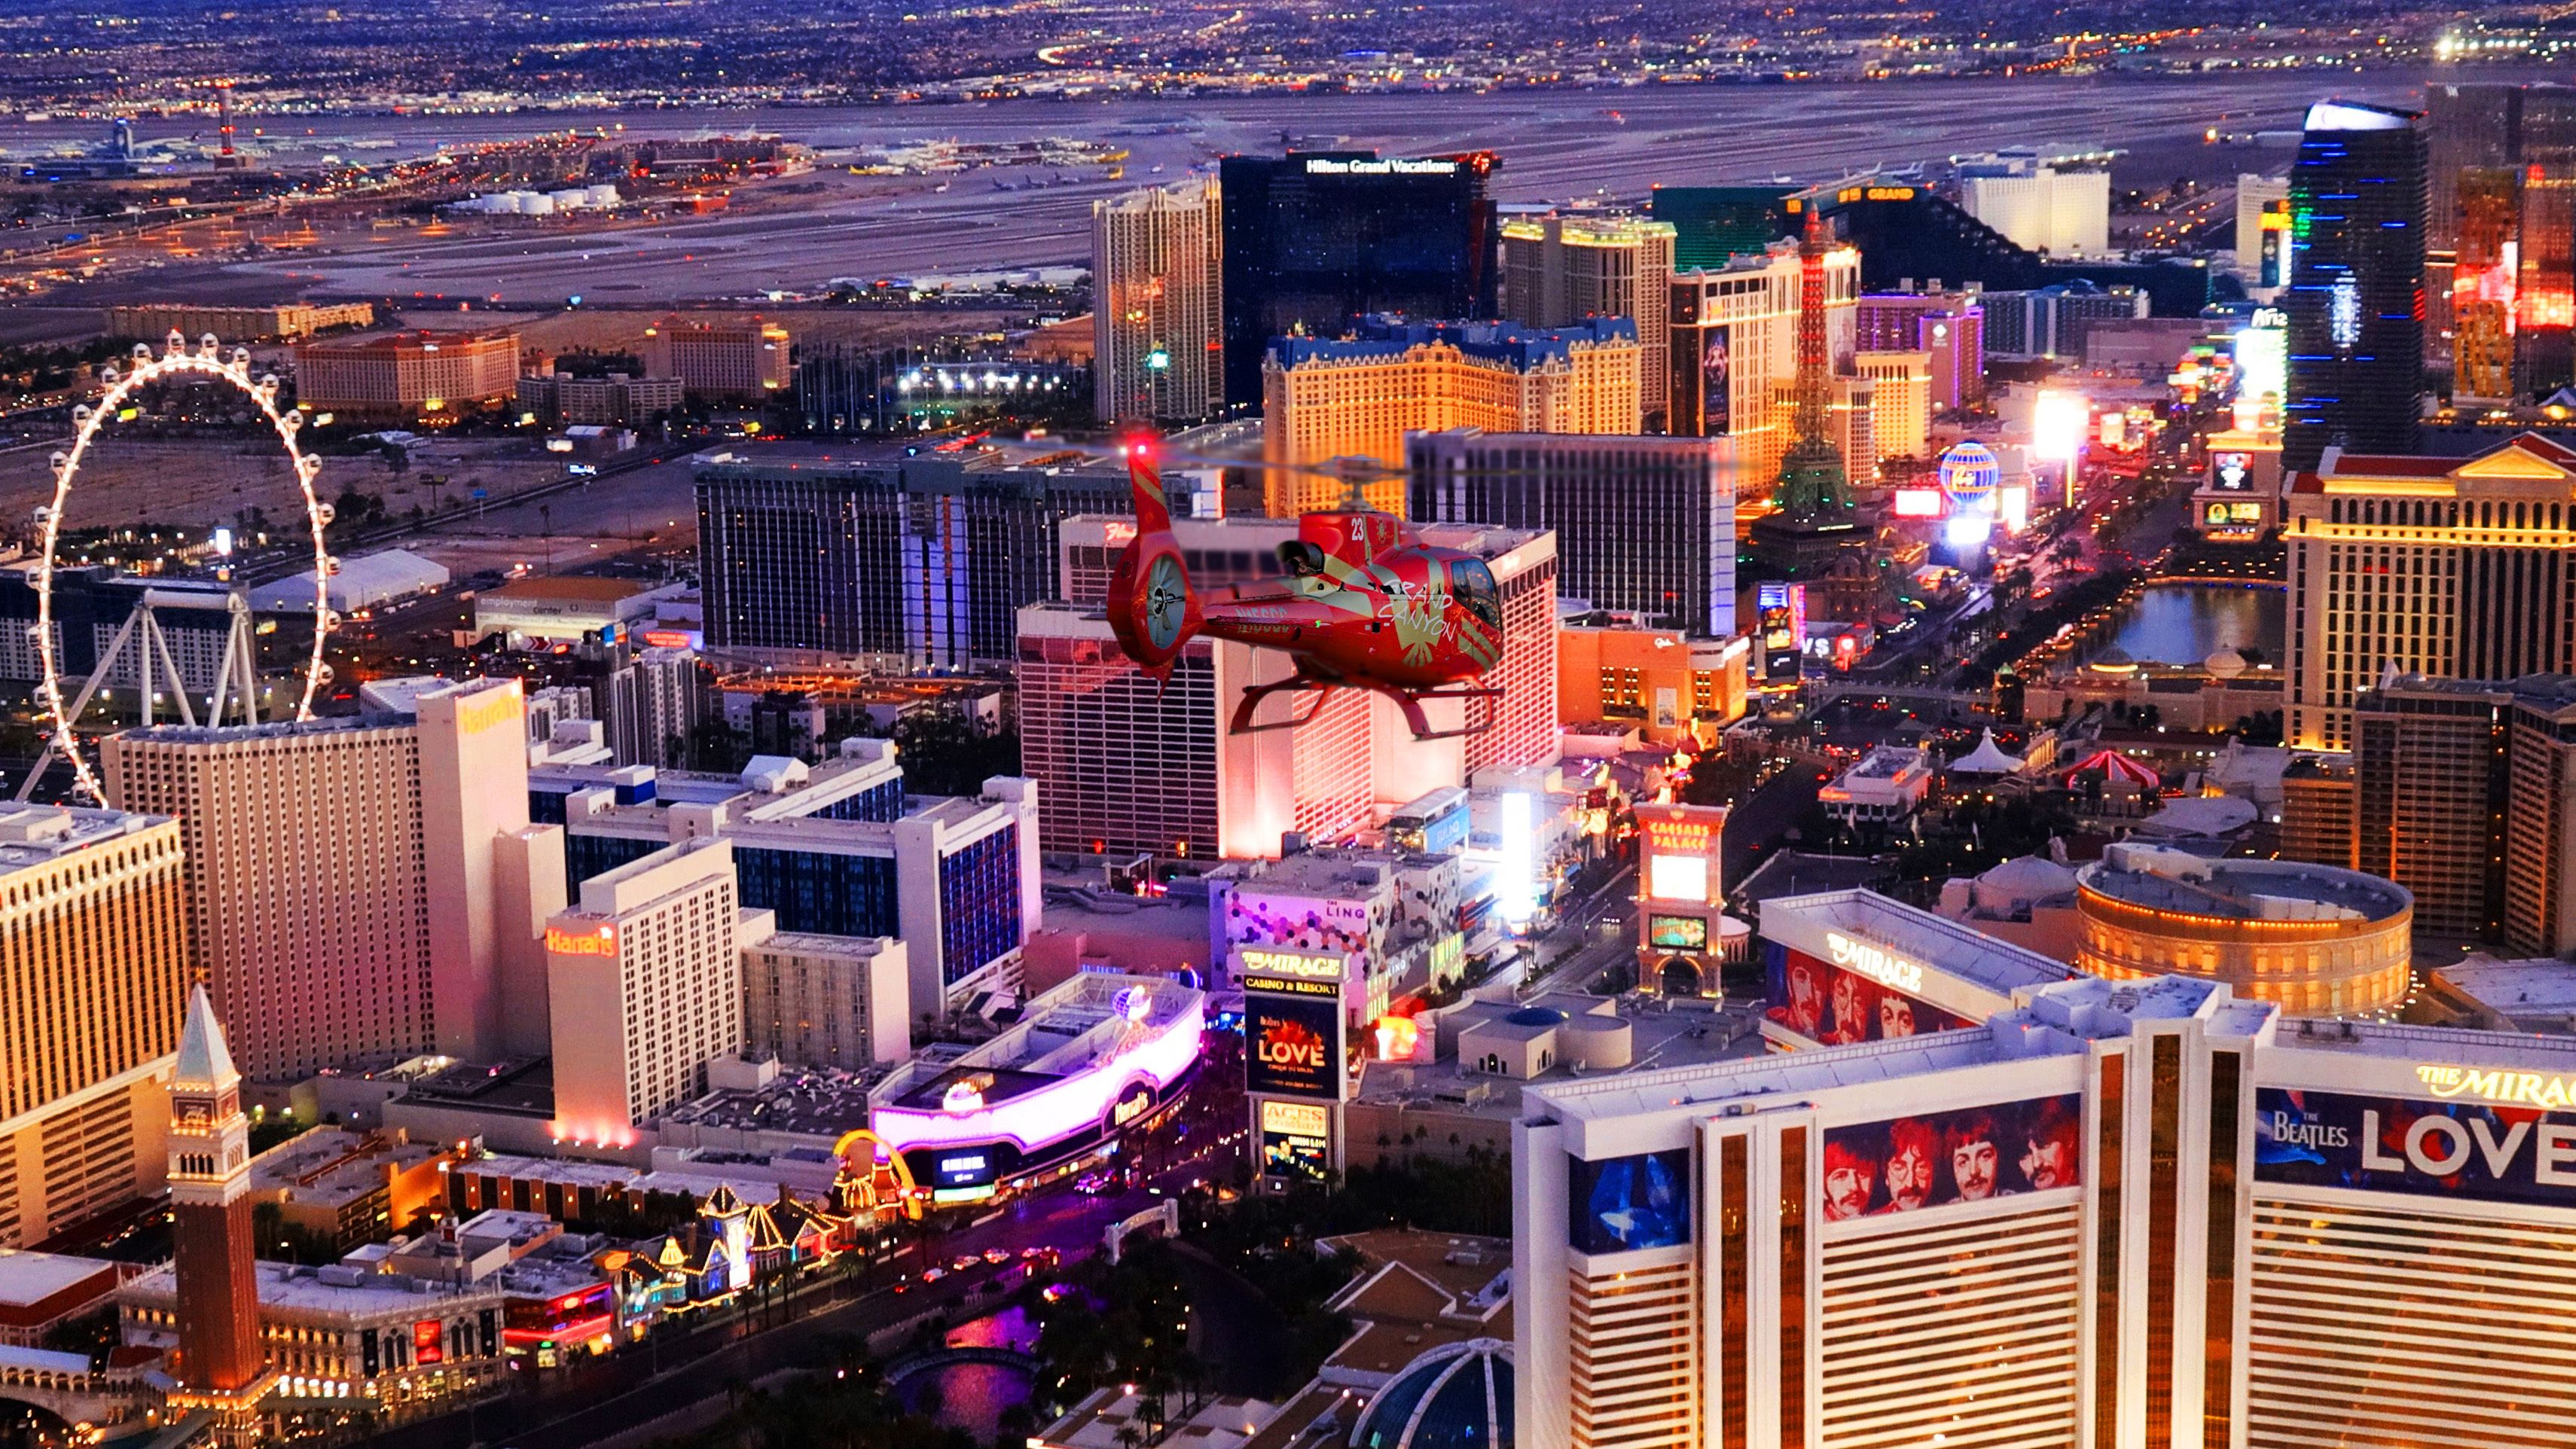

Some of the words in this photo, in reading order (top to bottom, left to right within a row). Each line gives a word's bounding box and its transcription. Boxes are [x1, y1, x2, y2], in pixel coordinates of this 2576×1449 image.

[1306, 160, 1348, 173] Hilton
[1350, 160, 1390, 173] Grand
[1392, 160, 1455, 173] Vacations
[1867, 188, 1915, 201] GRAND
[1351, 517, 1364, 541] 23
[1380, 578, 1453, 609] GRAND
[480, 597, 538, 607] employment
[533, 606, 562, 615] center
[1378, 602, 1457, 642] CANYON
[1649, 822, 1710, 837] CAESARS
[1653, 835, 1708, 850] PALACE
[1326, 906, 1366, 919] LINQ
[1827, 932, 1849, 953] THE
[1242, 951, 1264, 962] THE
[1247, 953, 1340, 977] MIRAGE
[1833, 941, 1922, 993] MIRAGE
[1246, 978, 1284, 990] CASINO
[1286, 981, 1294, 991] &
[1296, 981, 1337, 994] RESORT
[1258, 1039, 1326, 1067] LOVE
[2416, 1065, 2462, 1085] THE
[1267, 1106, 1323, 1121] ACES
[2303, 1112, 2319, 1121] THE
[2274, 1110, 2349, 1150] BEATLES
[2361, 1109, 2576, 1187] LOVE
